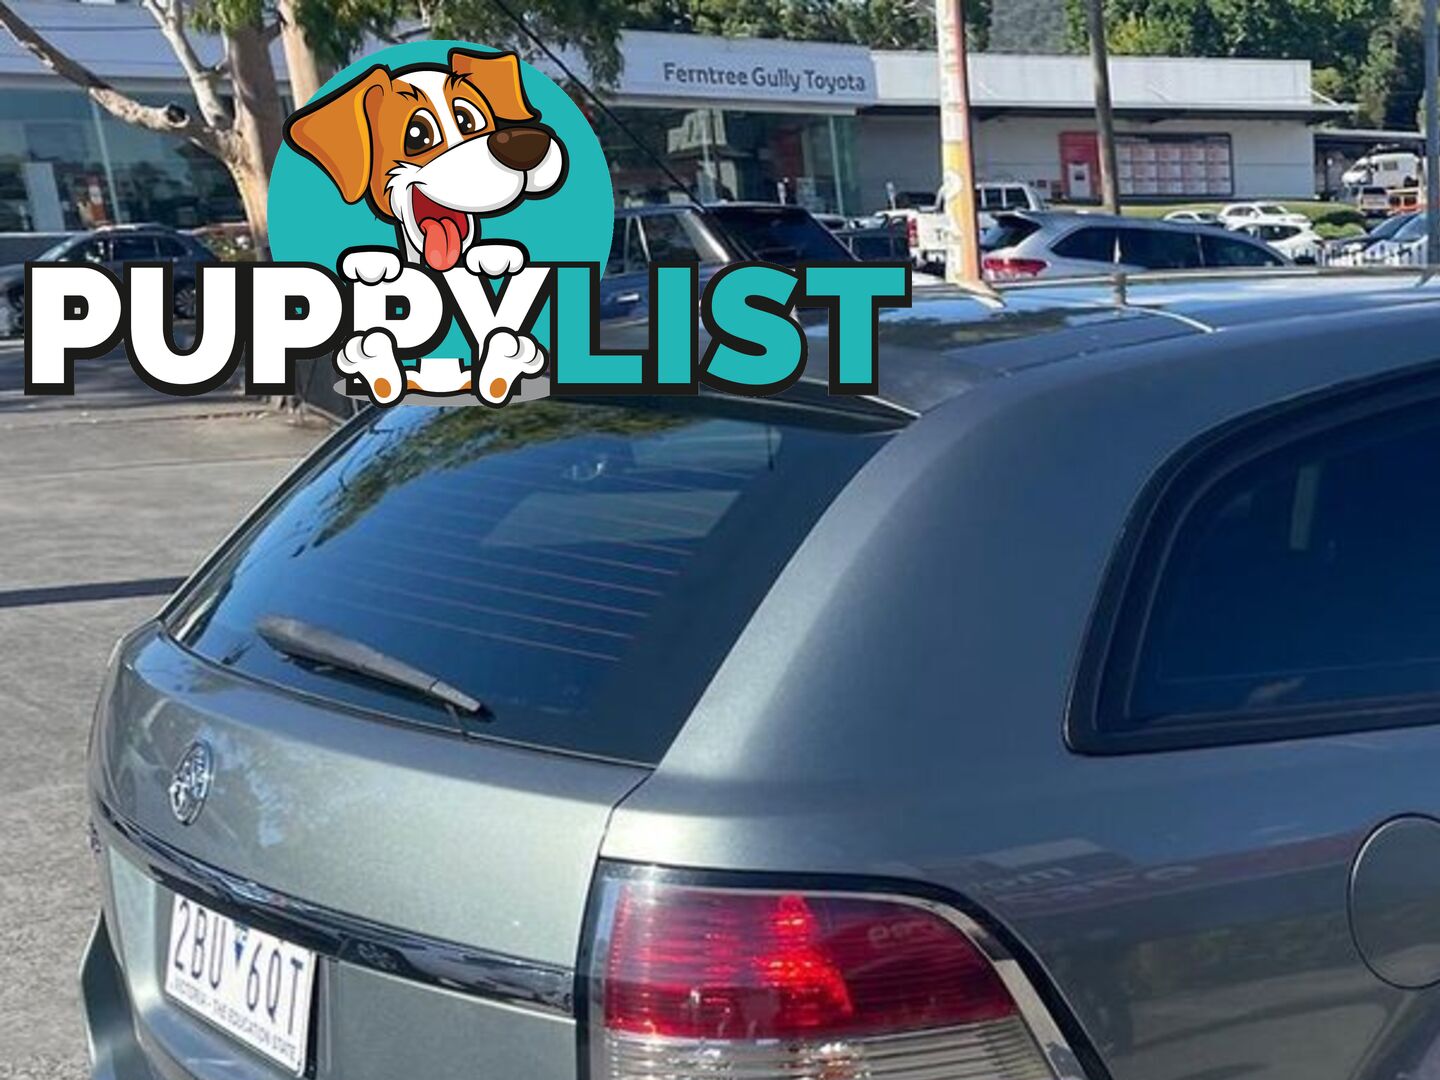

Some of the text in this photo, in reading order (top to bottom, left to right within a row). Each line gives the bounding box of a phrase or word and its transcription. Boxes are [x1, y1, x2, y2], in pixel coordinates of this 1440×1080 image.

[663, 62, 865, 94] Ferntree Gully Toyota
[174, 899, 304, 1035] 2BU 6QT
